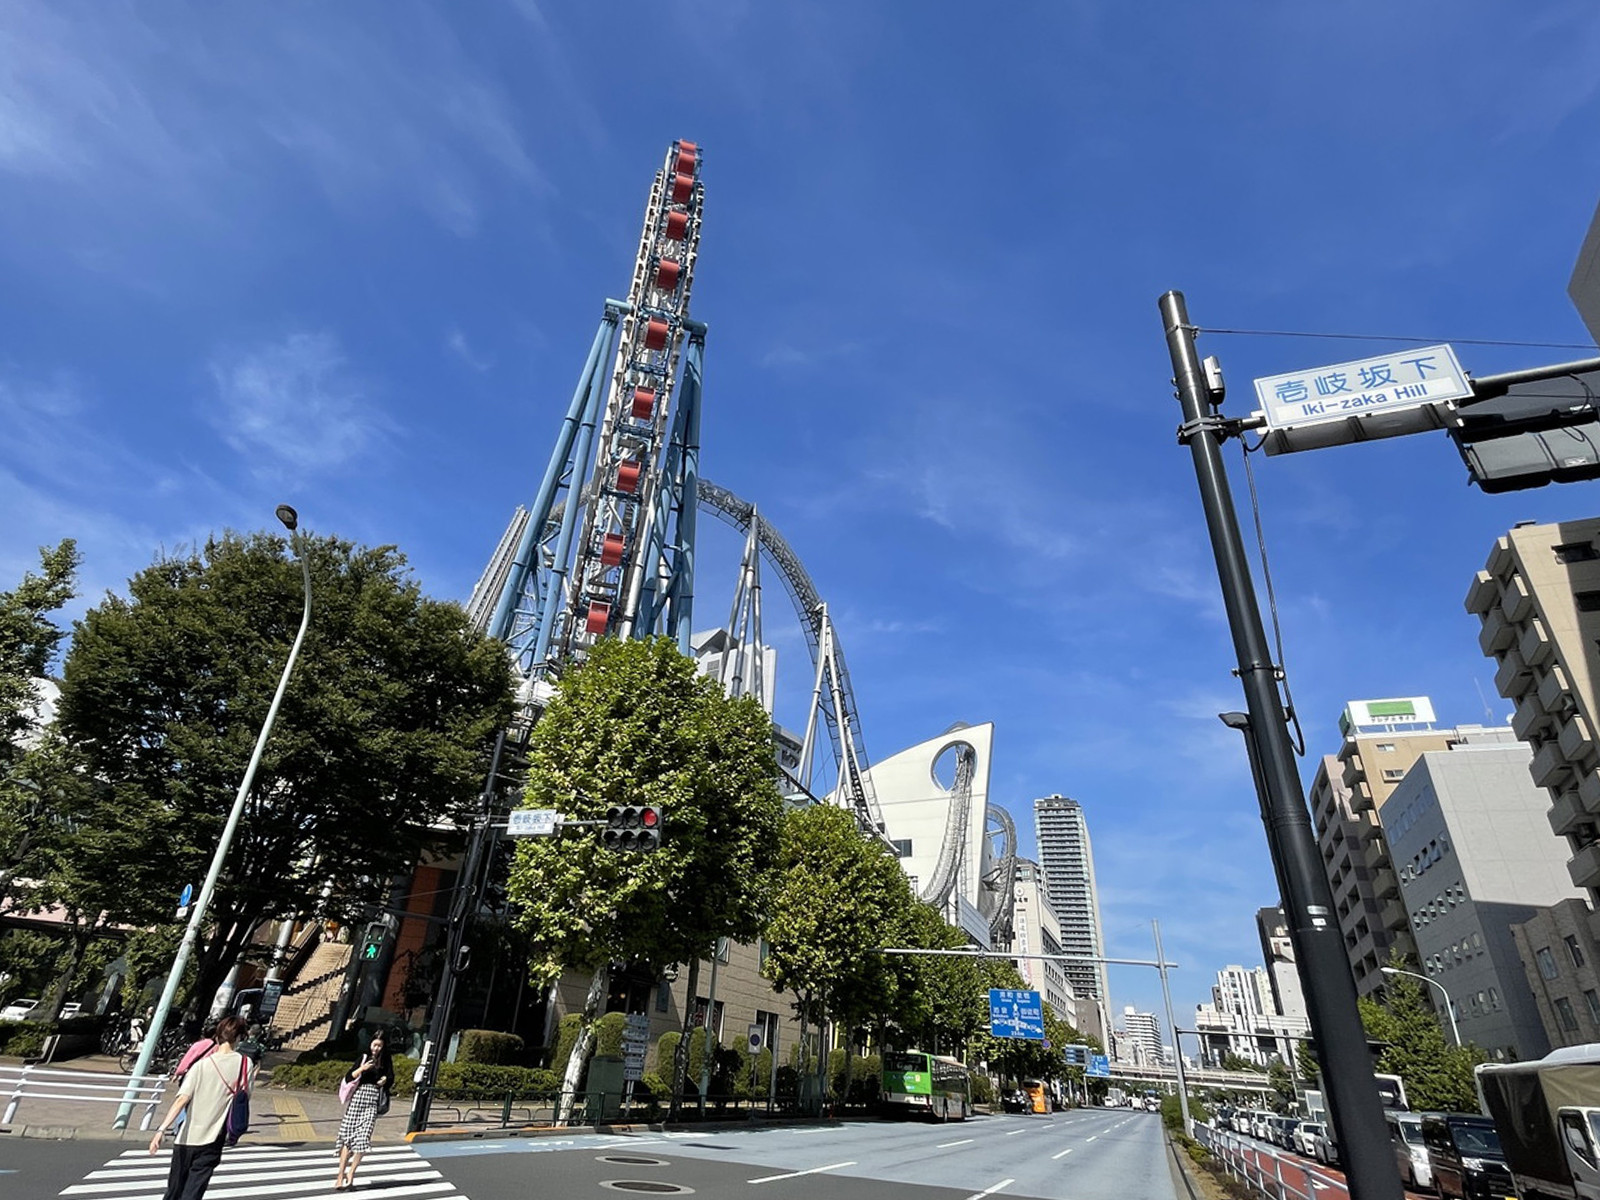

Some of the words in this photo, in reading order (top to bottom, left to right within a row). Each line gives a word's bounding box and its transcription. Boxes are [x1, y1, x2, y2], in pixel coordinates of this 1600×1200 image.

[1274, 355, 1437, 403] 壱岐坂下
[1302, 391, 1388, 416] Iki-zaka
[1394, 383, 1428, 400] Hill
